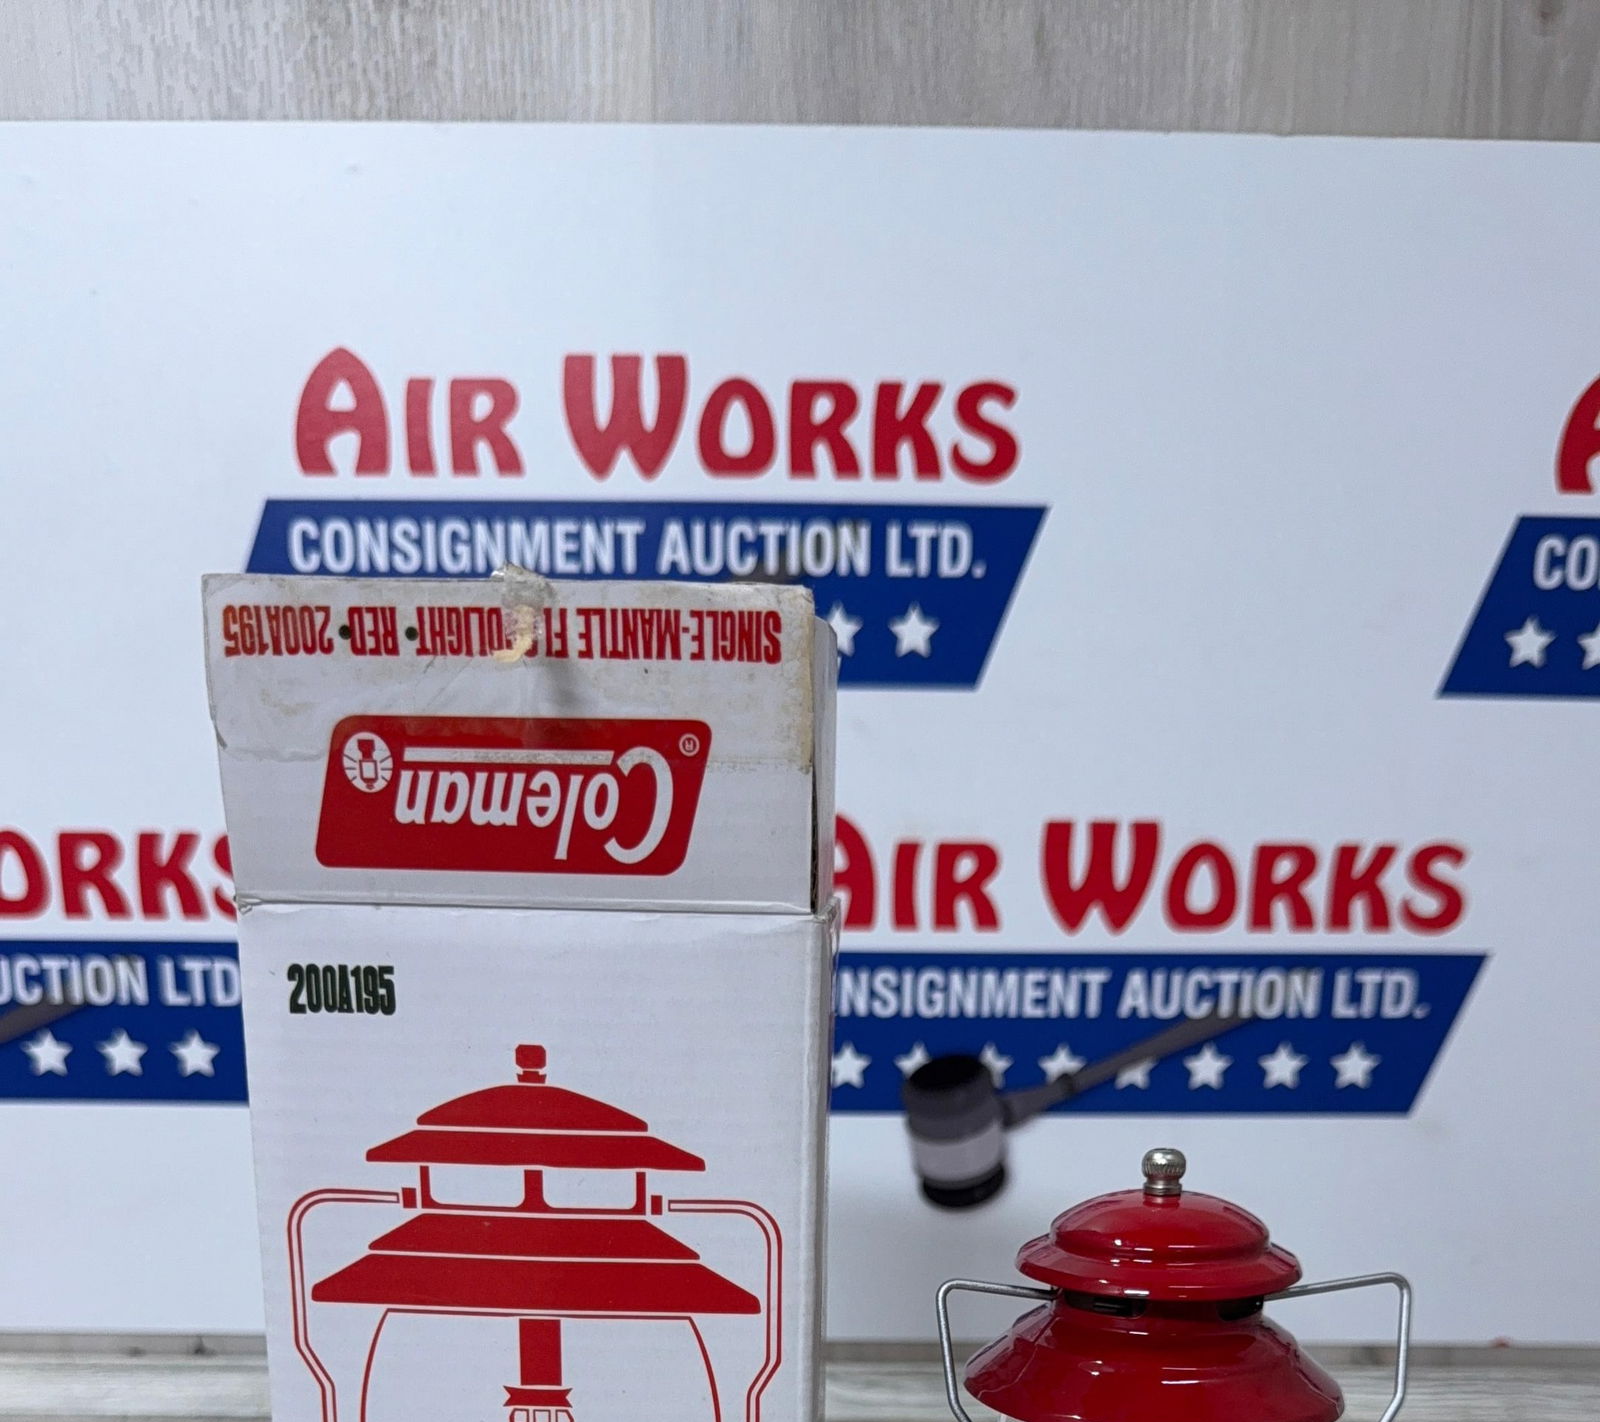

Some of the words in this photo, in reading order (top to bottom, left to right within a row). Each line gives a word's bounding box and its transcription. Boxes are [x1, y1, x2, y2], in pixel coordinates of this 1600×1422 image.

[295, 347, 523, 477] AIR
[563, 354, 1020, 483] WORKS
[288, 518, 646, 576] CONSIGNMENT
[657, 521, 871, 579] AUCTION
[886, 523, 985, 579] LTD.
[1533, 536, 1600, 591] CO
[222, 604, 334, 658] 200A195
[349, 605, 398, 657] RED
[416, 605, 568, 660] FLDLIGHT
[577, 606, 783, 665] SINGLE-MANTLE
[394, 746, 675, 865] Coleman
[1041, 820, 1466, 935] WORKS
[287, 962, 396, 1016] 200A195
[1117, 969, 1322, 1020] AUCTION
[1331, 970, 1428, 1020] LTD.
